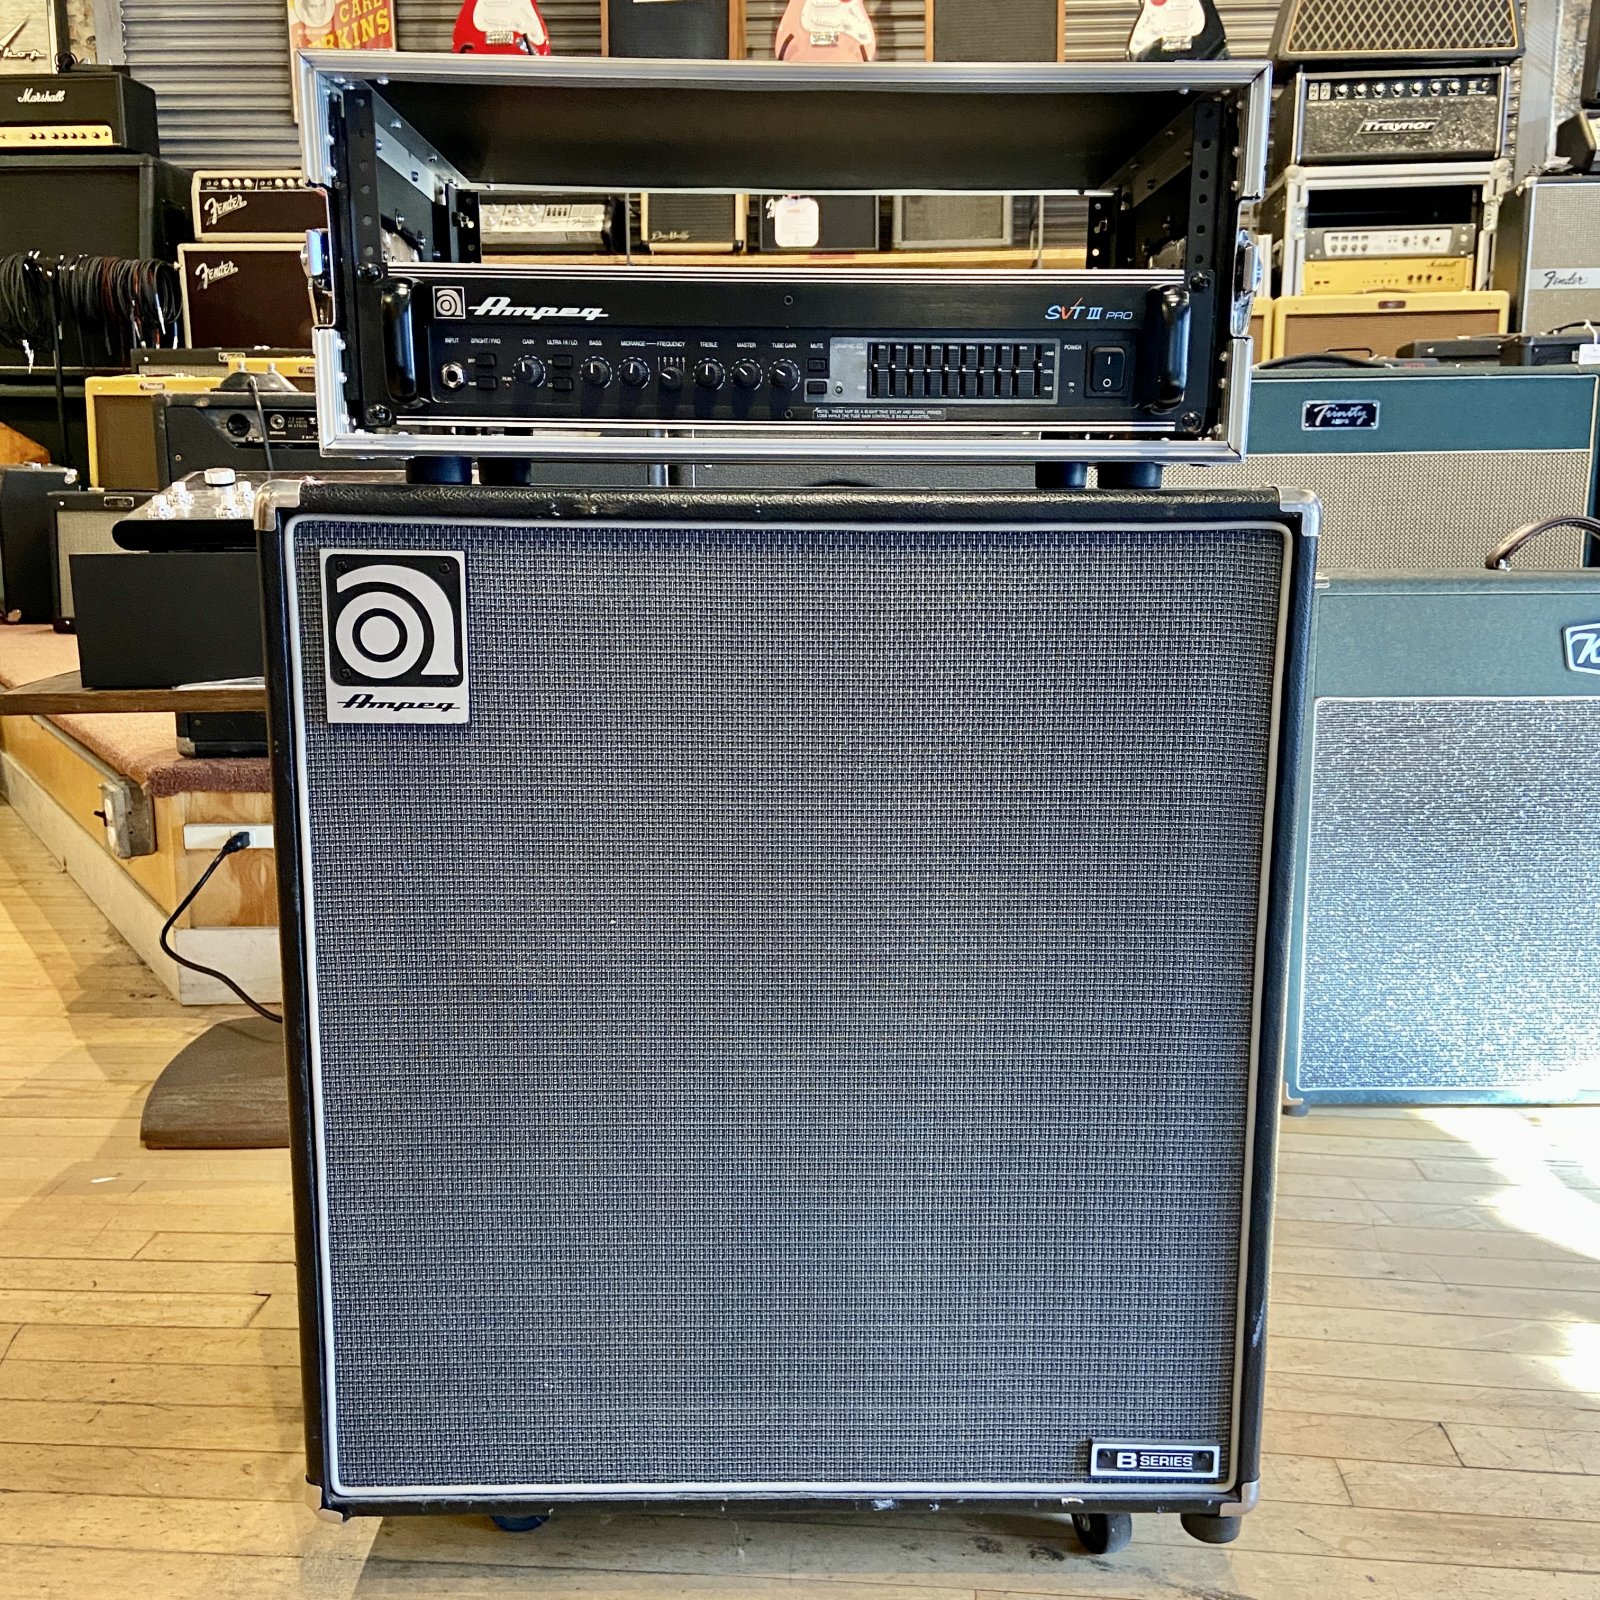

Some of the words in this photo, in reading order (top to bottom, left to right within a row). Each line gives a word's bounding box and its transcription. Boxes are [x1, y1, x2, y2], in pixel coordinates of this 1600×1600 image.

[0, 47, 46, 60] hop
[17, 88, 66, 103] Marshall
[1364, 121, 1436, 132] Traynor
[204, 194, 247, 226] Fender
[195, 261, 238, 289] Fender
[468, 296, 609, 320] Ampeg
[1045, 298, 1086, 320] SVT
[1086, 307, 1104, 320] III
[1105, 311, 1134, 320] PRO
[1313, 404, 1368, 426] Trinity
[337, 693, 461, 712] Ampeg
[1117, 1452, 1137, 1468] B
[1139, 1455, 1193, 1467] SERIES
